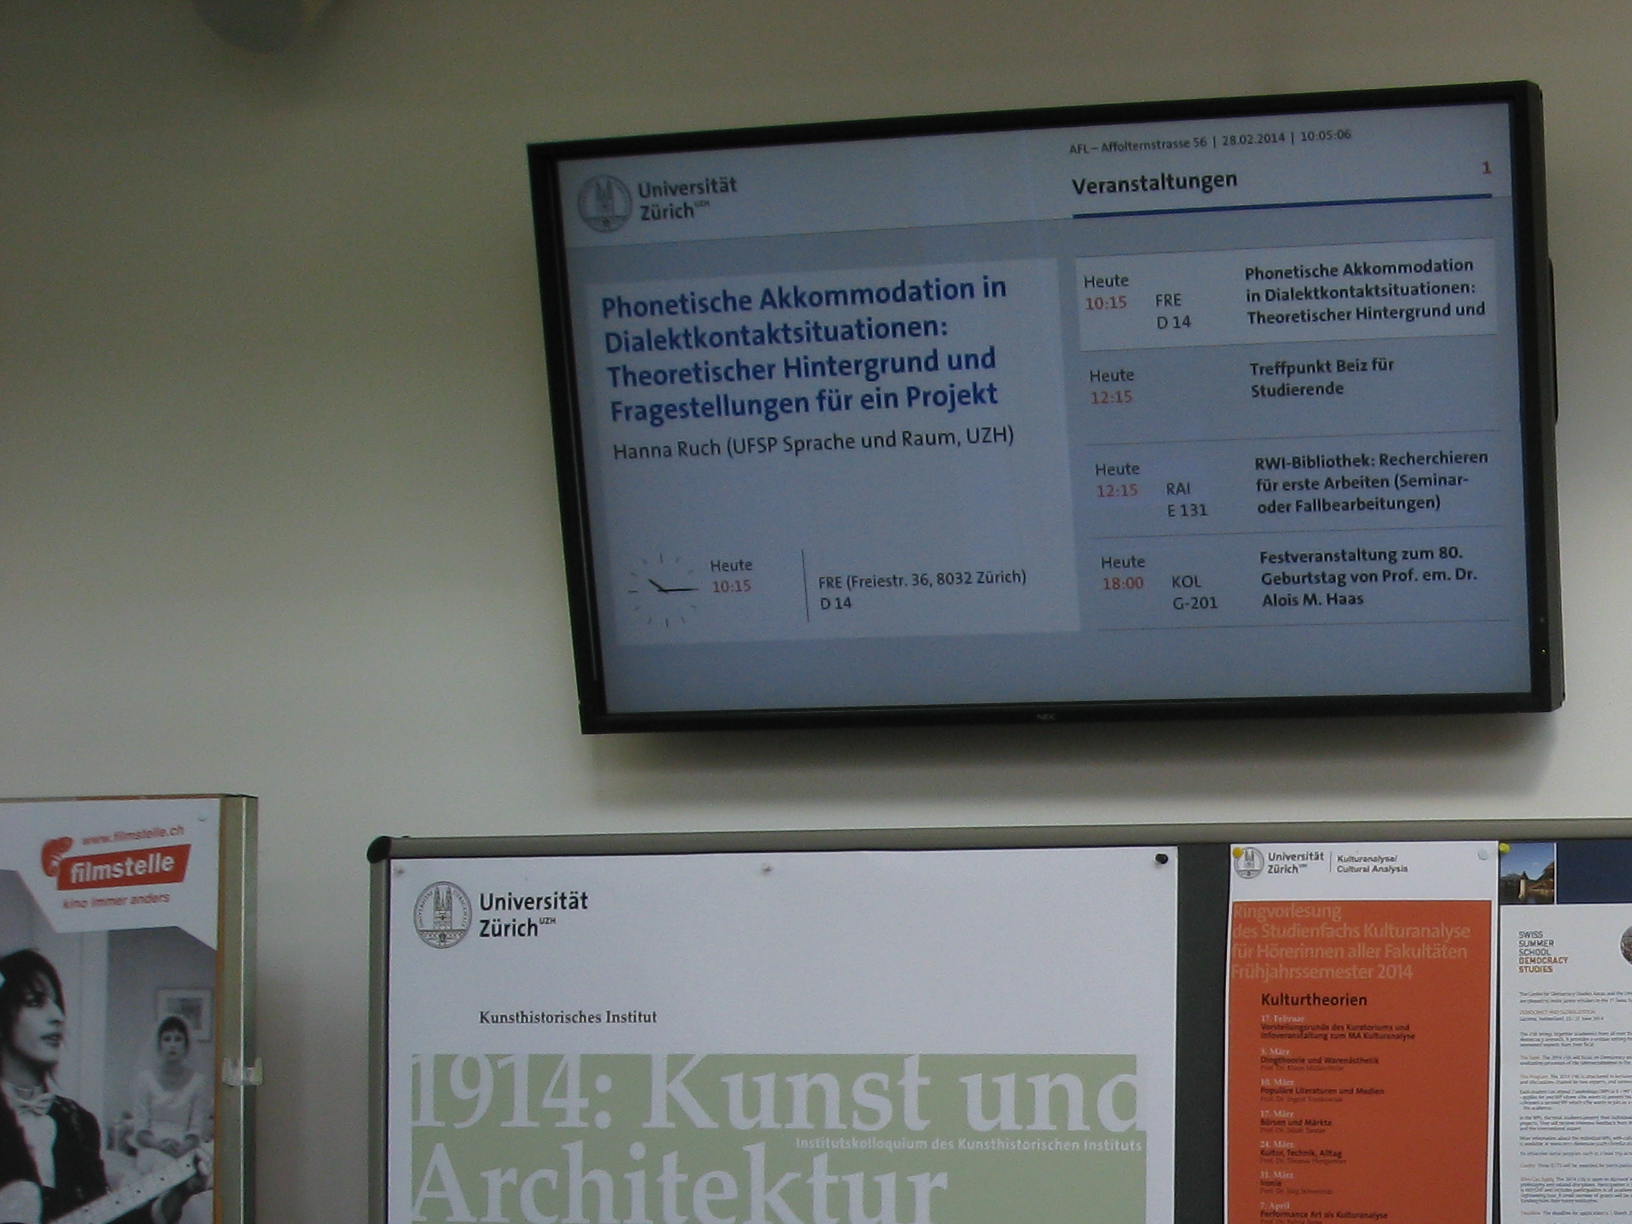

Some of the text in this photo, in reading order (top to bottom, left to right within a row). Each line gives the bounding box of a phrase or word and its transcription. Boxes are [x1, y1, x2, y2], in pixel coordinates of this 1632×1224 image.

[1069, 129, 1352, 154] AFL Affolternstrasse 56 28.02.2014 10:05:06
[1482, 162, 1492, 174] 1
[638, 177, 737, 199] Universität
[1072, 171, 1238, 196] Veranstaltungen
[1245, 258, 1473, 281] Phonetische Akkommodation
[1084, 274, 1129, 289] Heute
[602, 276, 1007, 319] Phonetische Akkommodation in
[1246, 281, 1476, 303] in Dialektkontaktsituationen:
[1086, 293, 1181, 310] 10:15 FRE
[1157, 315, 1192, 329] D 14
[1247, 302, 1486, 326] Theoretischer Hintergrund und
[605, 318, 947, 354] Dialektkontaktsituationen:
[607, 346, 996, 388] Theoretischer Hintergrund und
[1089, 368, 1135, 382] Heute
[1250, 357, 1394, 378] Treffpunkt Beiz für
[1091, 390, 1132, 404] 12:15
[1252, 382, 1344, 398] Studierende
[611, 382, 998, 427] Fragestellungen für ein Projekt
[614, 425, 1014, 460] Hanna Ruch (UFSP Sprache und Raum, UZH)
[1255, 450, 1488, 471] RWI-Bibliothek: Recherchieren
[1095, 463, 1140, 476] Heute
[1097, 482, 1191, 498] 12:15 RAI
[1256, 472, 1468, 492] für erste Arbeiten (Seminar-
[1168, 504, 1207, 517] E 131
[1257, 495, 1441, 514] oder Fallbearbeitungen)
[1101, 556, 1146, 569] Heute
[1260, 546, 1462, 565] Festveranstaltung zum 80.
[710, 559, 752, 572] Heute
[713, 580, 751, 593] 10:15
[819, 570, 1026, 590] FRE (Freiestr. 36, 8032 Zürich)
[1103, 575, 1201, 590] 18:00 KOL
[1261, 568, 1477, 588] Geburtstag von Prof. em. Dr.
[820, 597, 851, 610] D 14
[1173, 596, 1218, 610] G-201
[1262, 592, 1364, 607] Alois M. Haas
[1268, 852, 1324, 862] Universität
[71, 852, 174, 884] filmstelle
[1337, 865, 1408, 874] Cultural Analysis
[480, 891, 588, 911] Universität
[1234, 903, 1341, 921] Ringvorlesung
[1233, 923, 1471, 941] des Studienfachs Kulturanalyse
[1519, 931, 1543, 939] SWISS
[1232, 945, 1252, 958] für
[1348, 944, 1380, 958] aller
[1385, 943, 1467, 959] Fakultäten
[1519, 957, 1568, 965] DEMOCRACY
[1232, 964, 1413, 984] Frühjahrssemester 2014
[1262, 993, 1367, 1006] Kulturtheorien
[479, 1010, 657, 1024] Kunsthistorisches Institut
[411, 1054, 1146, 1132] 1914: Kunst und
[796, 1137, 1142, 1152] Institutskolloquium des Kunsthistorischen Instituts
